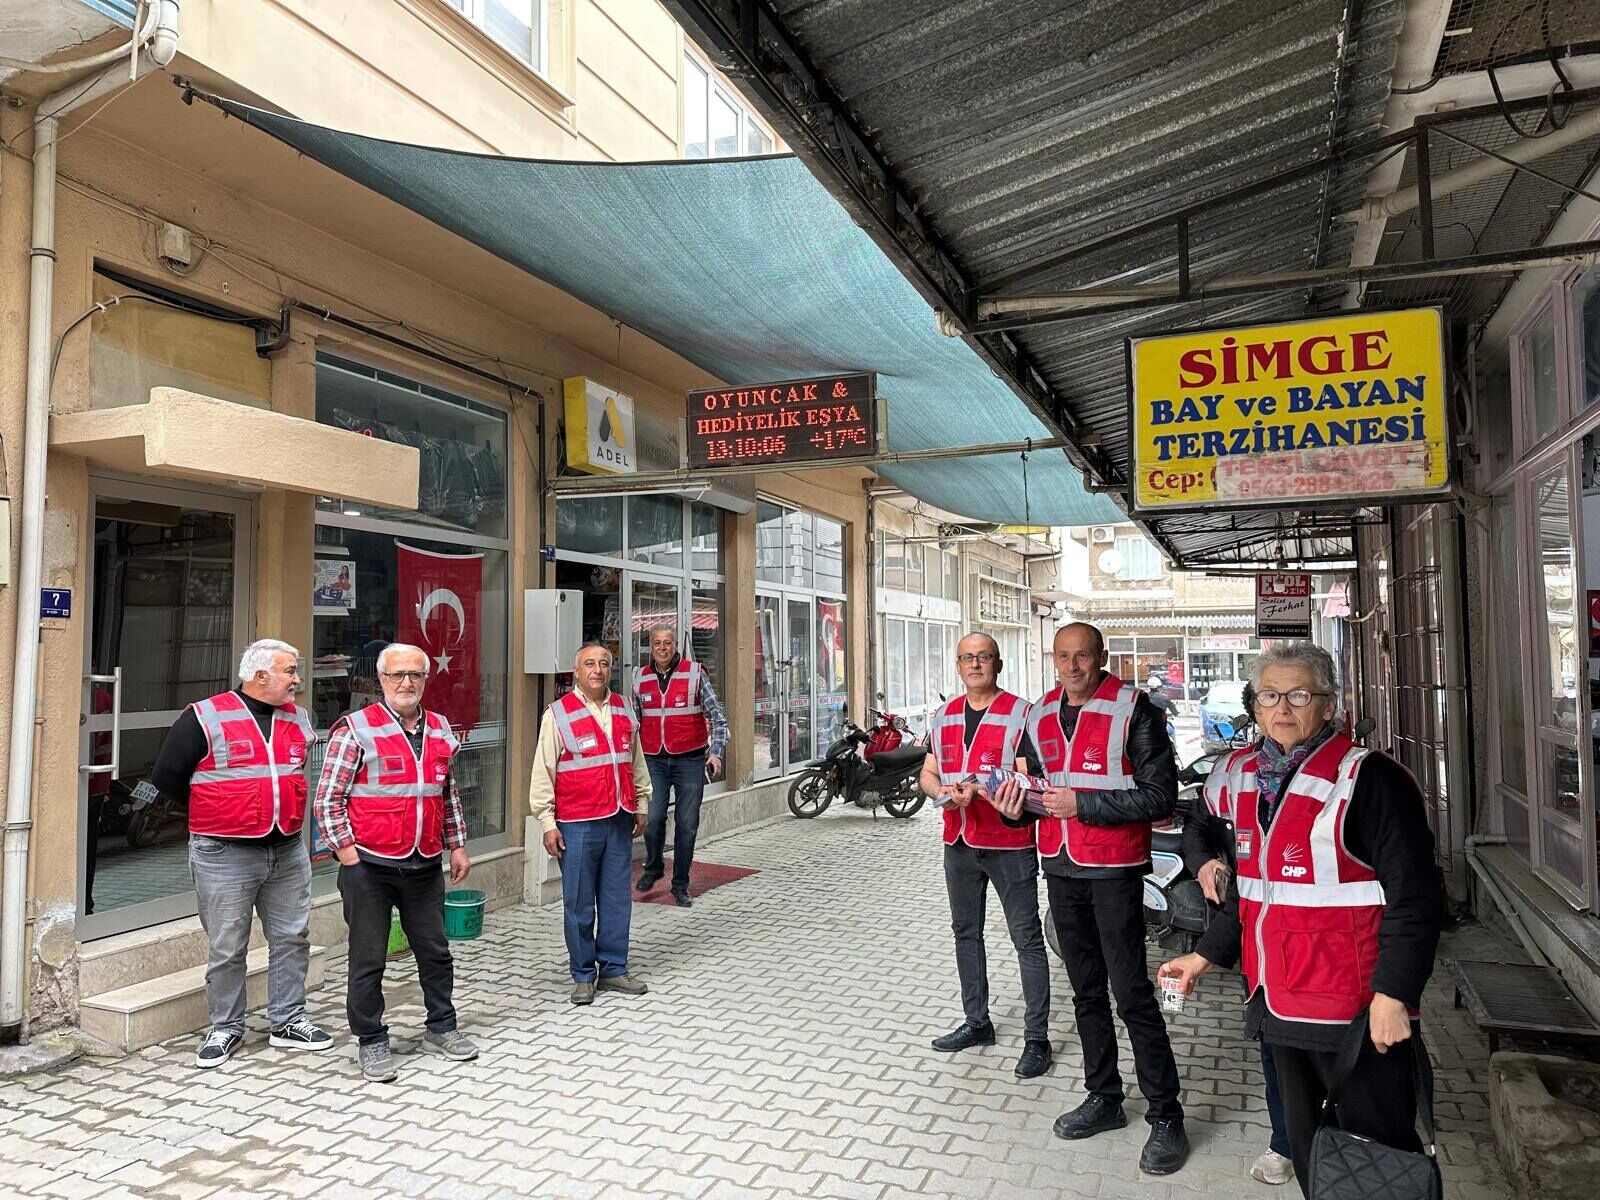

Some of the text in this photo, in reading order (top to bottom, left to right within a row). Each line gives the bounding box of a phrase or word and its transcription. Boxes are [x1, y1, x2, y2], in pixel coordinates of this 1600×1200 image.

[1179, 330, 1392, 389] SİMGE
[704, 382, 848, 410] OYUNCAK &
[1150, 375, 1426, 425] BAY ve BAYAN
[697, 405, 861, 435] HEDİYELİK EŞYA
[1153, 406, 1426, 461] TERZİHANESİ
[597, 446, 629, 467] ADEL
[1148, 470, 1204, 494] Cep:
[52, 593, 60, 606] 7
[1262, 600, 1305, 618] Ferhat
[979, 763, 997, 772] CH
[1082, 761, 1102, 772] CHP
[1281, 865, 1307, 878] CHP
